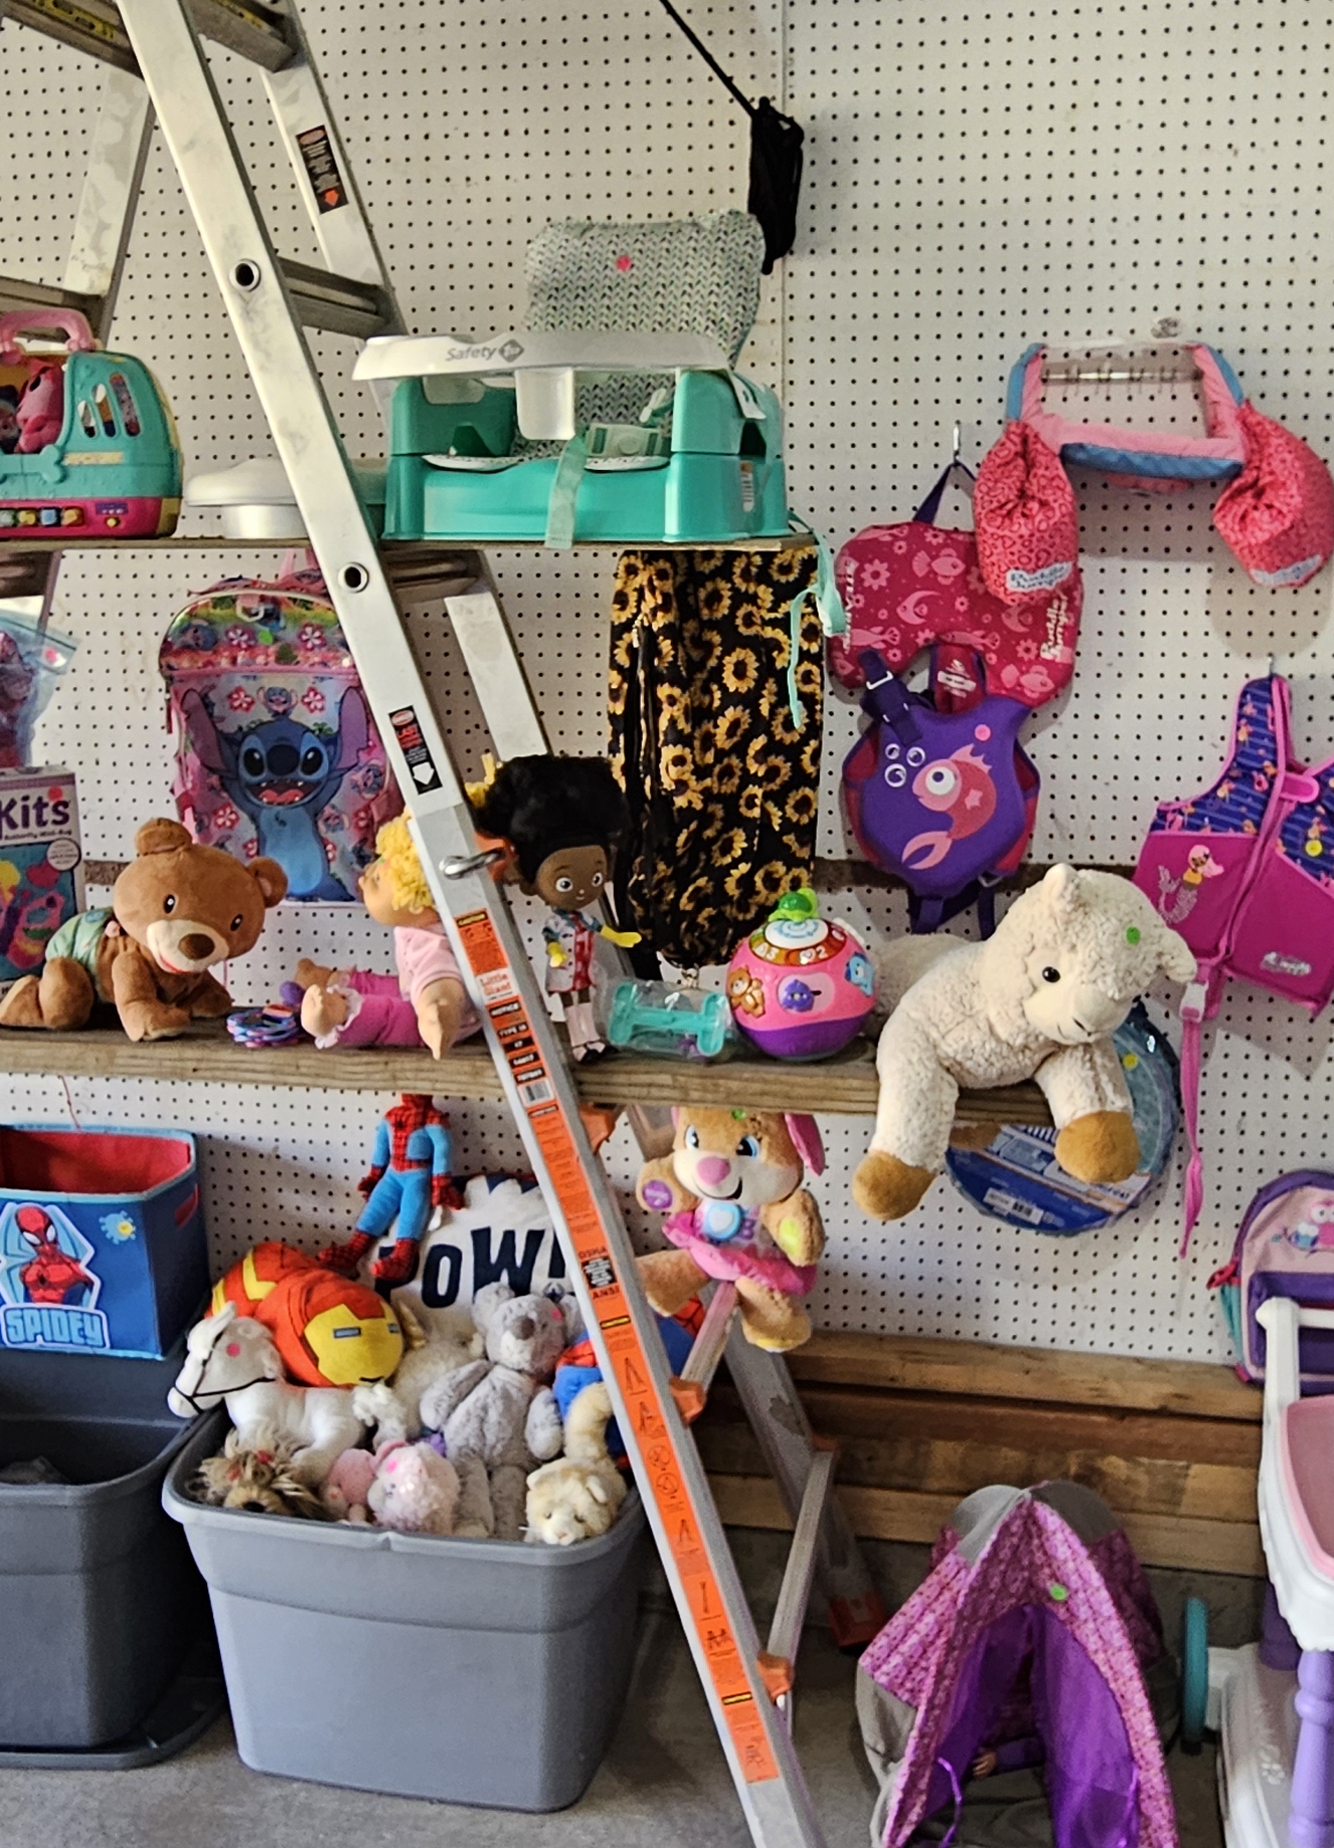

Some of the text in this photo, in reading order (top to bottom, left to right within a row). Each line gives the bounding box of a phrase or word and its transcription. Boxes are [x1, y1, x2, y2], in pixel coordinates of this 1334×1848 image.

[445, 346, 497, 362] Safety
[816, 945, 829, 960] 2
[5, 1308, 104, 1348] SPIDEY
